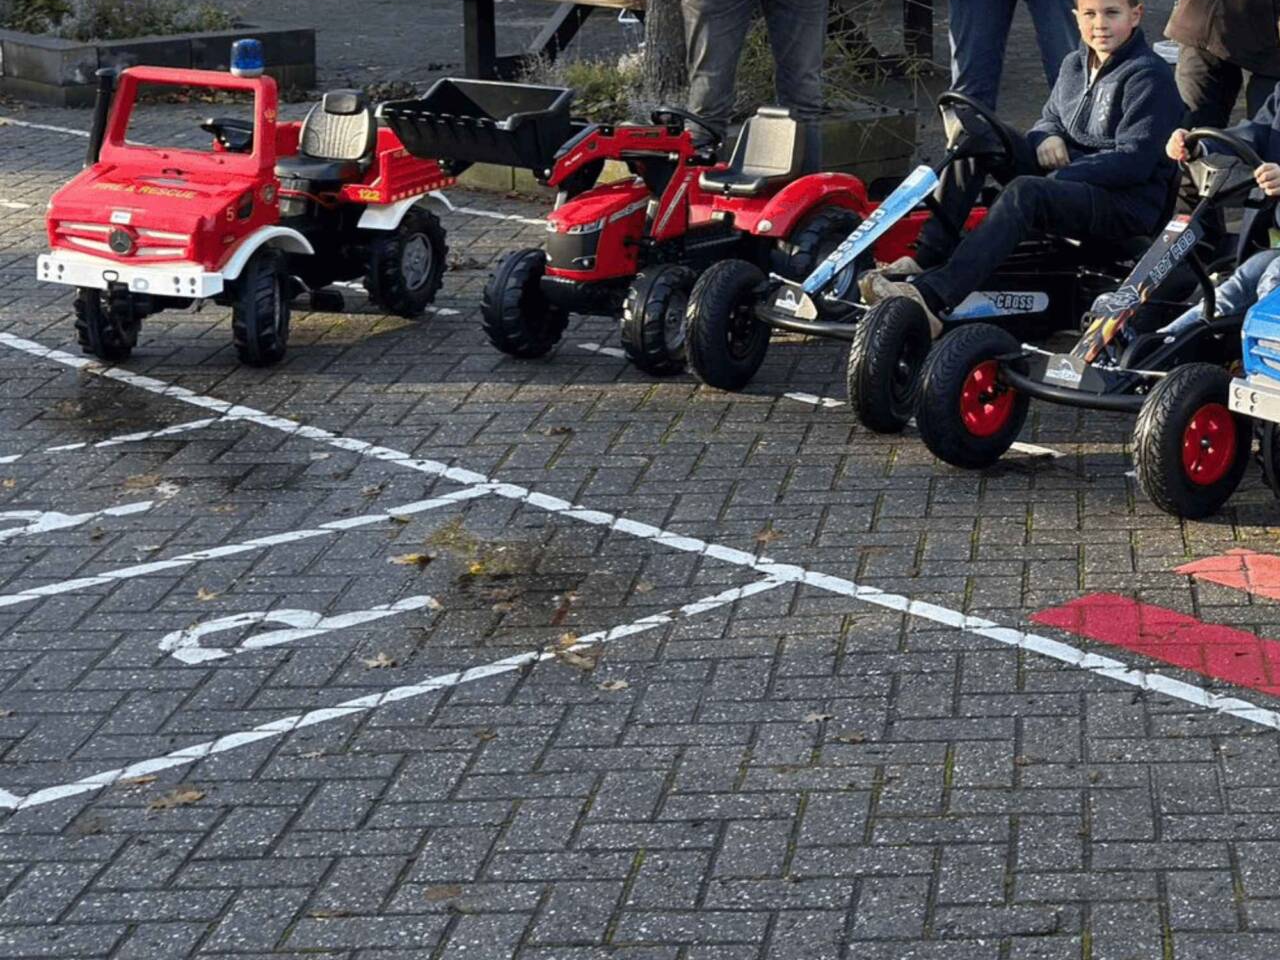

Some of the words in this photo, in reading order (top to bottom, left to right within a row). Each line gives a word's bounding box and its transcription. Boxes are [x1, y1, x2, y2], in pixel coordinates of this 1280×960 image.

[358, 189, 381, 202] 122
[225, 206, 236, 222] 5
[827, 207, 887, 264] CROSS
[1149, 251, 1174, 285] HOT
[995, 294, 1035, 310] CROSS
